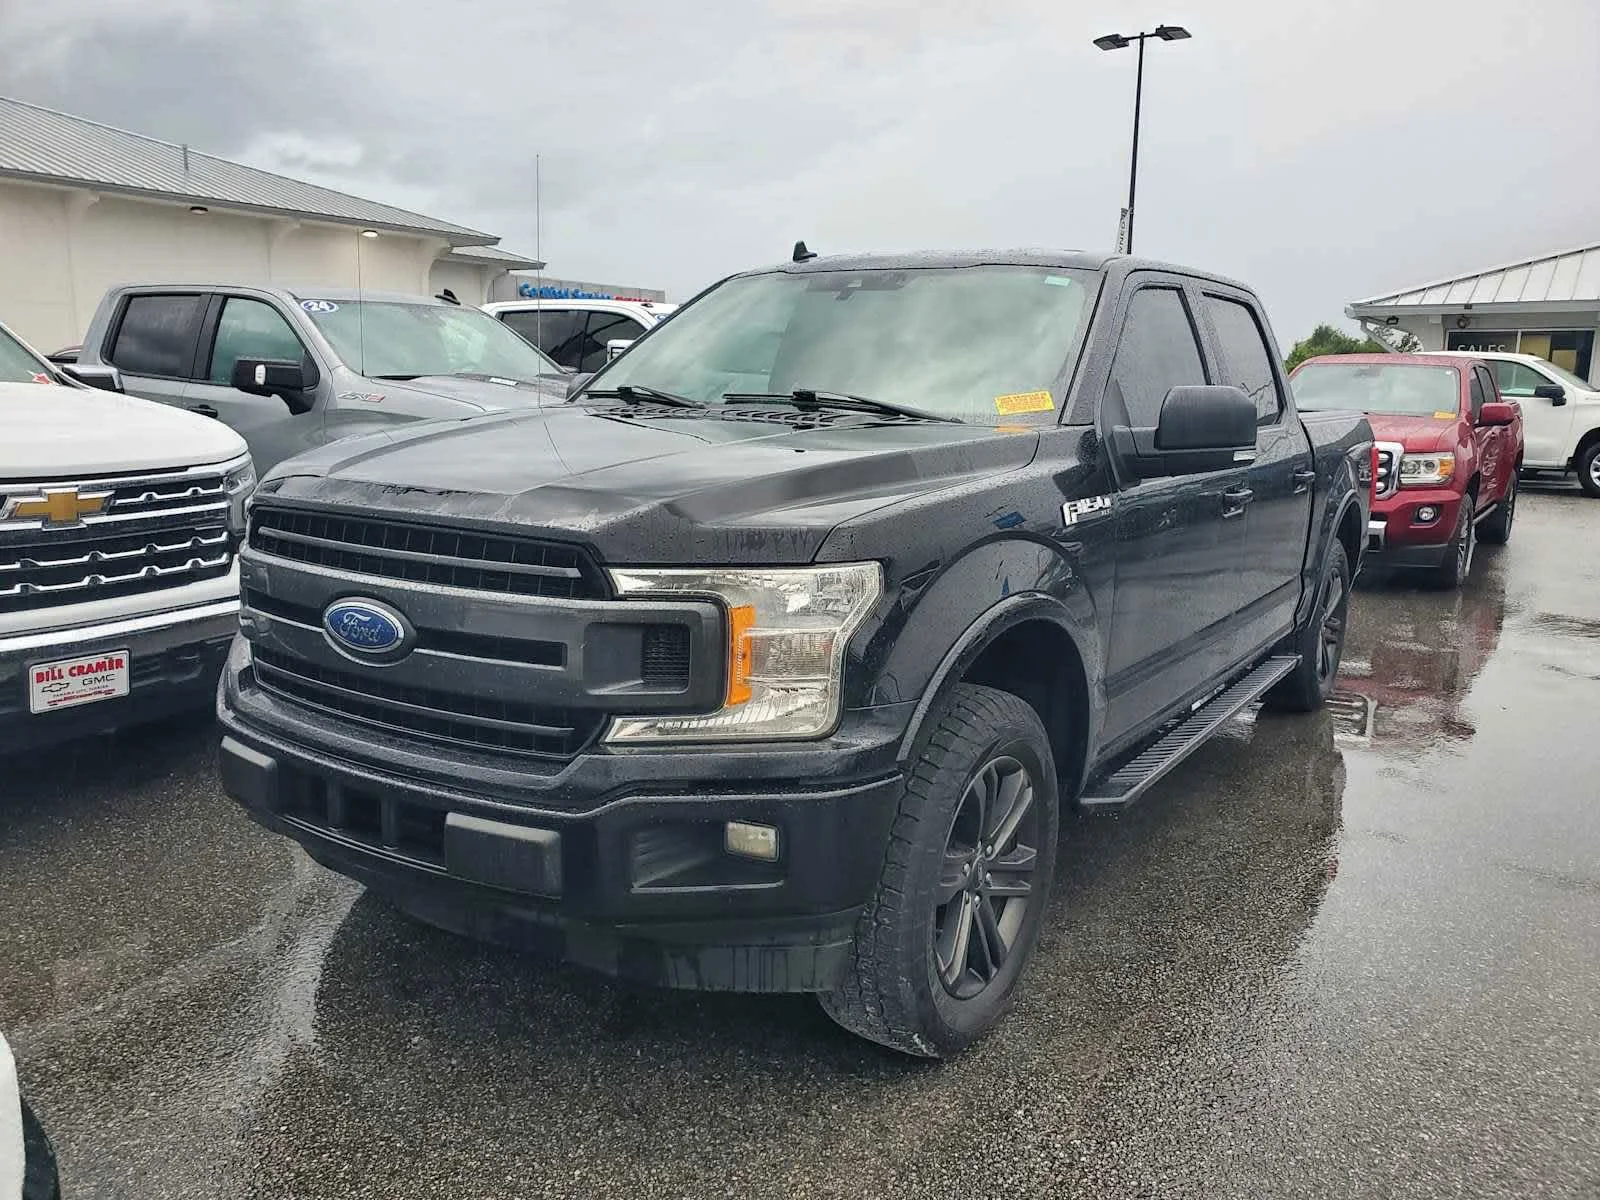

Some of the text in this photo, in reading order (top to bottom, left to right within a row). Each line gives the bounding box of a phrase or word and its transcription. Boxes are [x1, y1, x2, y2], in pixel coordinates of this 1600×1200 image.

[340, 611, 382, 643] Ford
[35, 657, 125, 684] BILL CRAMER
[82, 673, 116, 686] GMC
